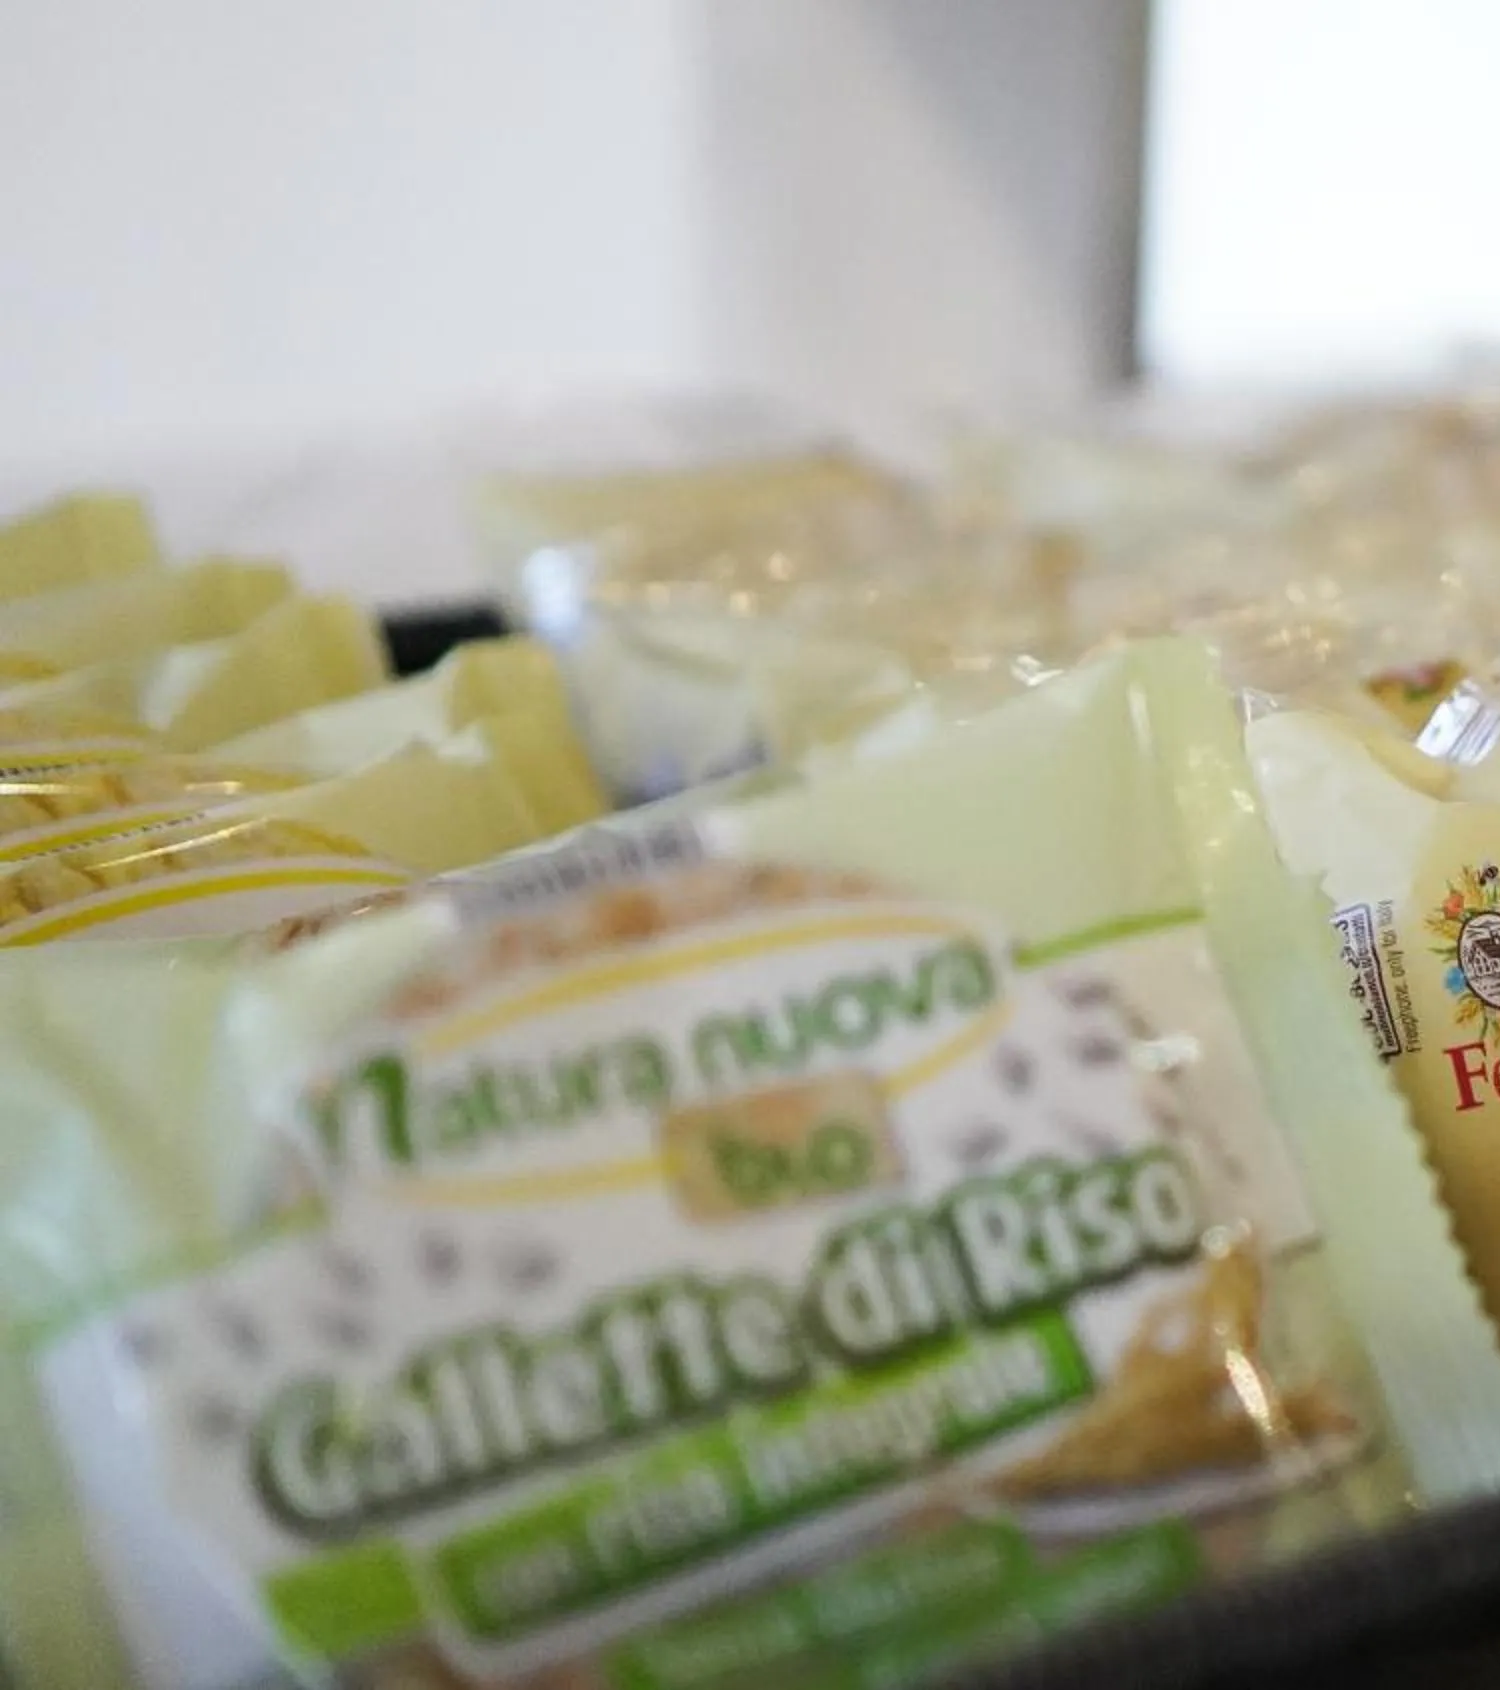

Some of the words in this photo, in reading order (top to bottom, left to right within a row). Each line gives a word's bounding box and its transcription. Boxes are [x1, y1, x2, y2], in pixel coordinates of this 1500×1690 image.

[260, 1278, 797, 1526] Gallette
[816, 1210, 943, 1361] di
[950, 1156, 1200, 1312] Riso
